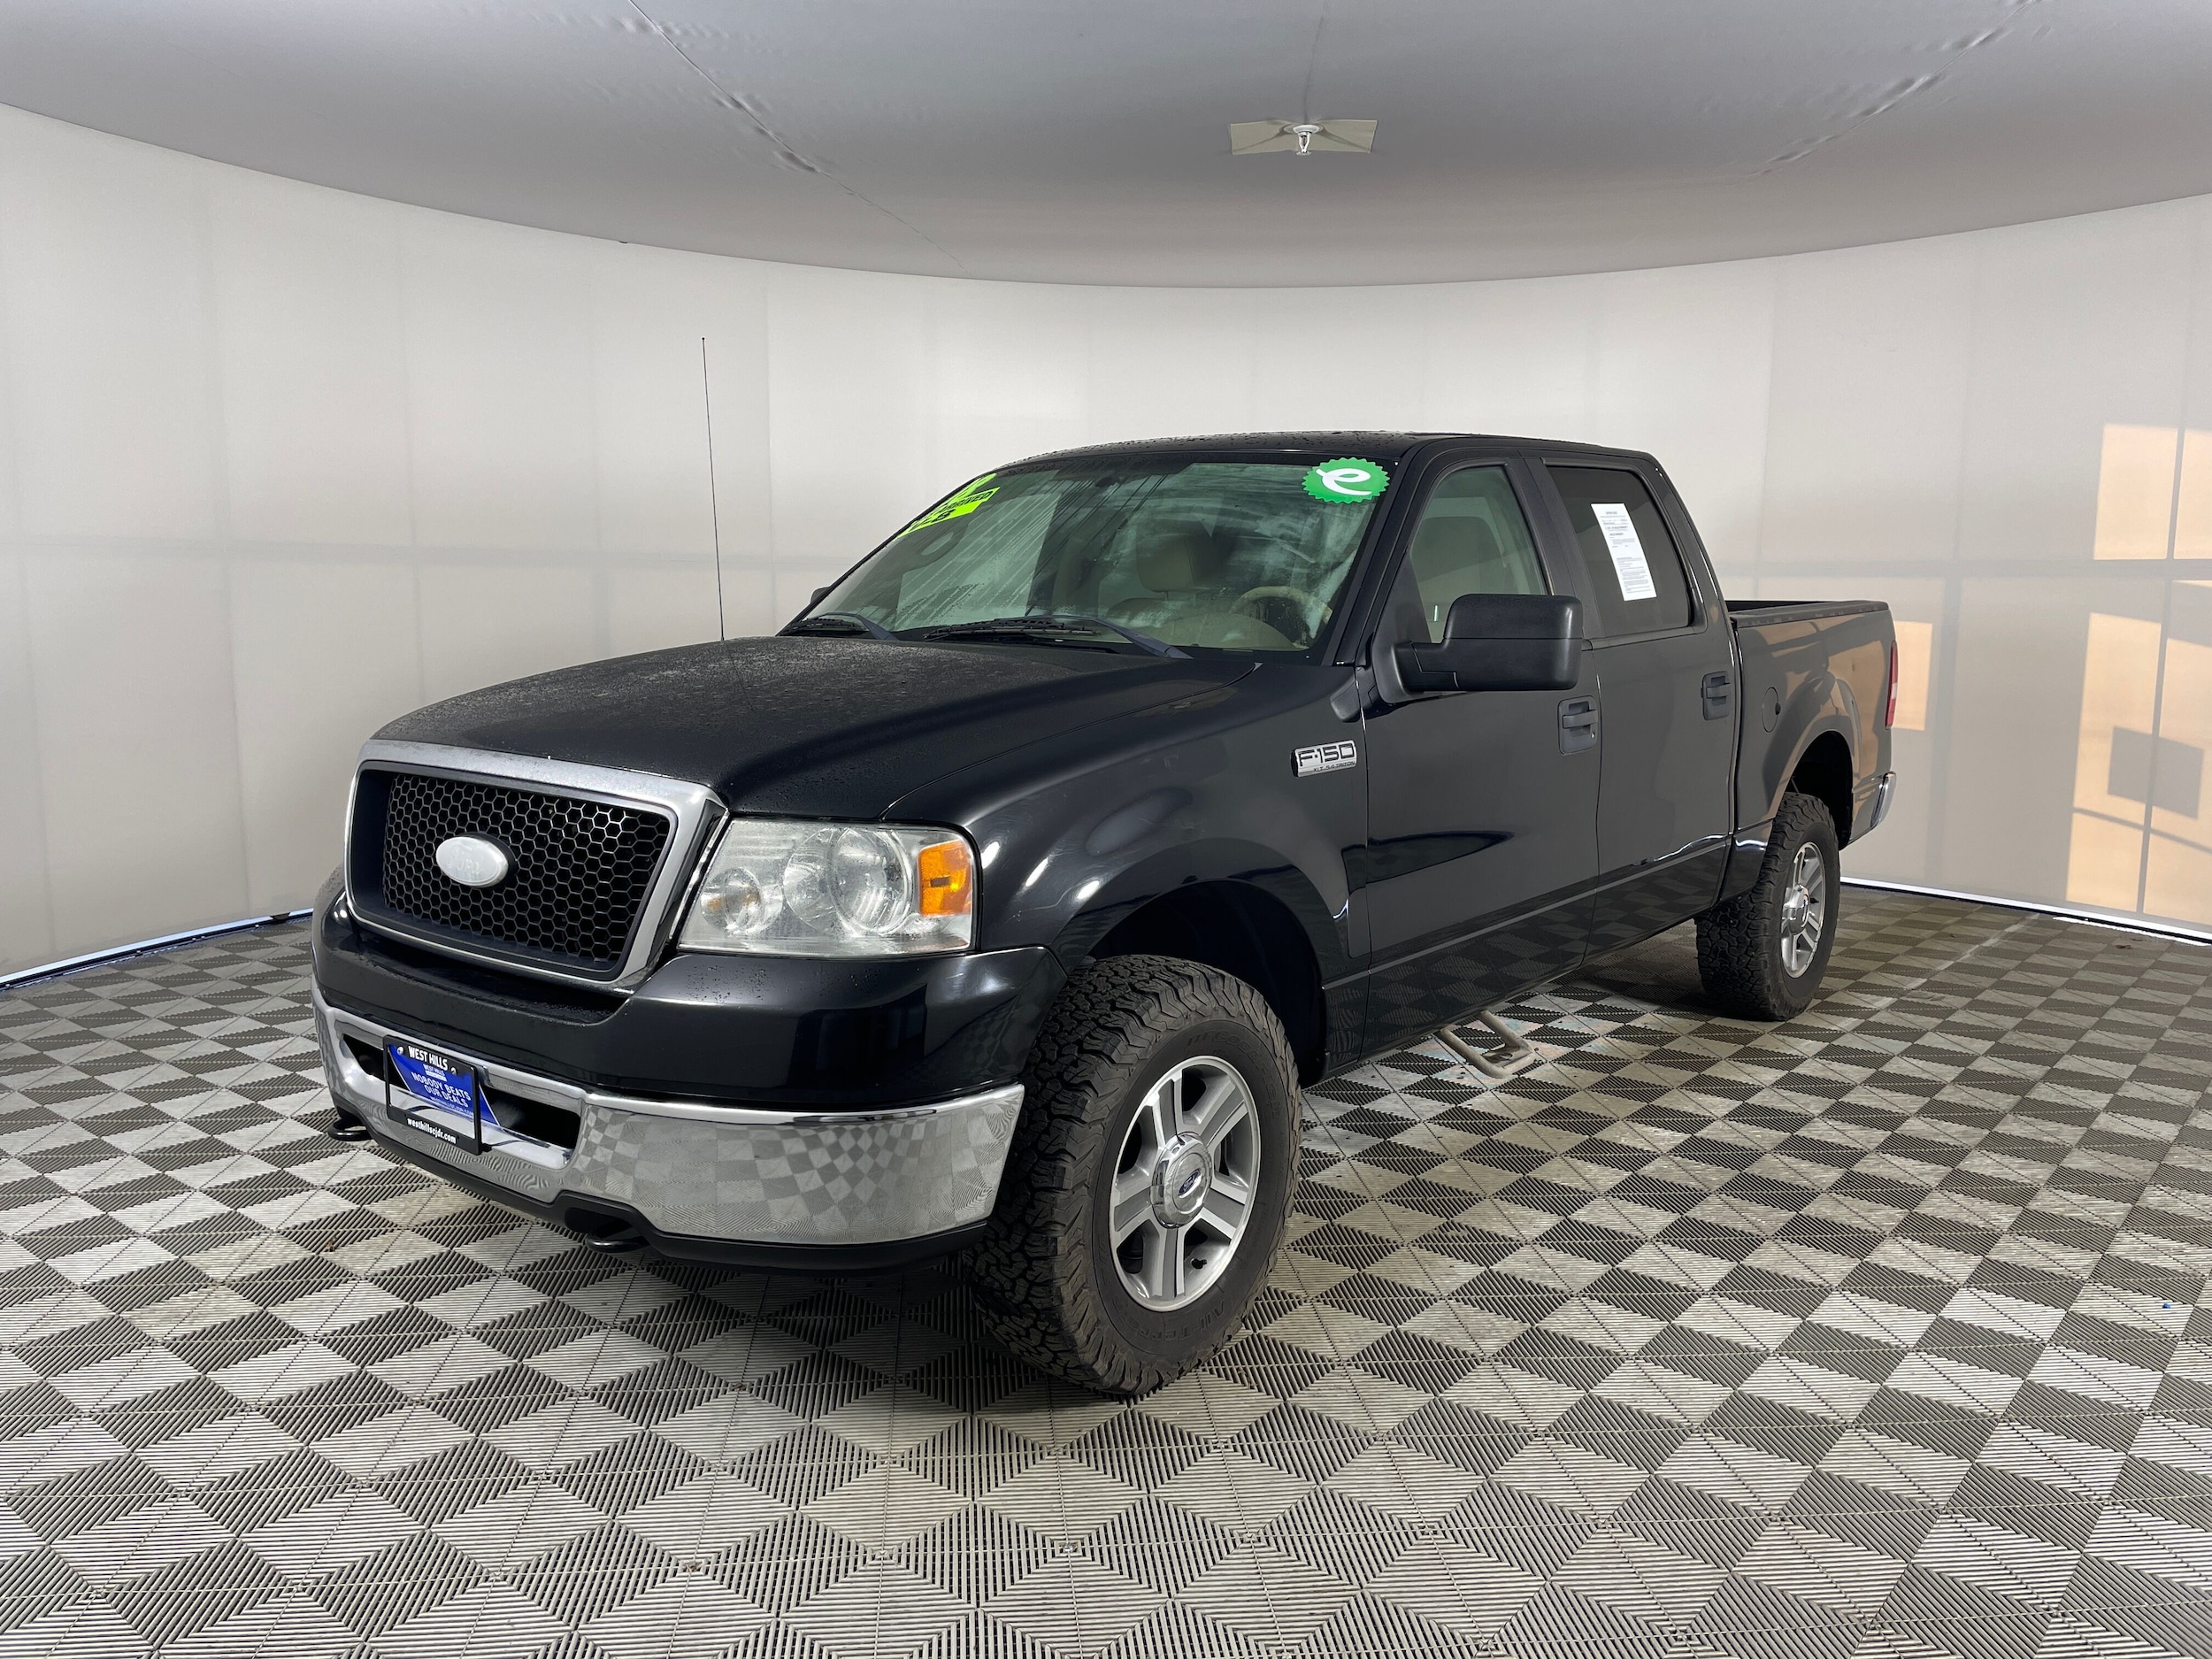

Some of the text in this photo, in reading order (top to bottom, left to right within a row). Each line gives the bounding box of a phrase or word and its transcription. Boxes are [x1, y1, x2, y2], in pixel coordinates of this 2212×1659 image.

[408, 1046, 449, 1071] WEST HILLS
[411, 1072, 444, 1091] NOBODY
[444, 1084, 472, 1101] BEATS
[424, 1085, 441, 1097] OUR
